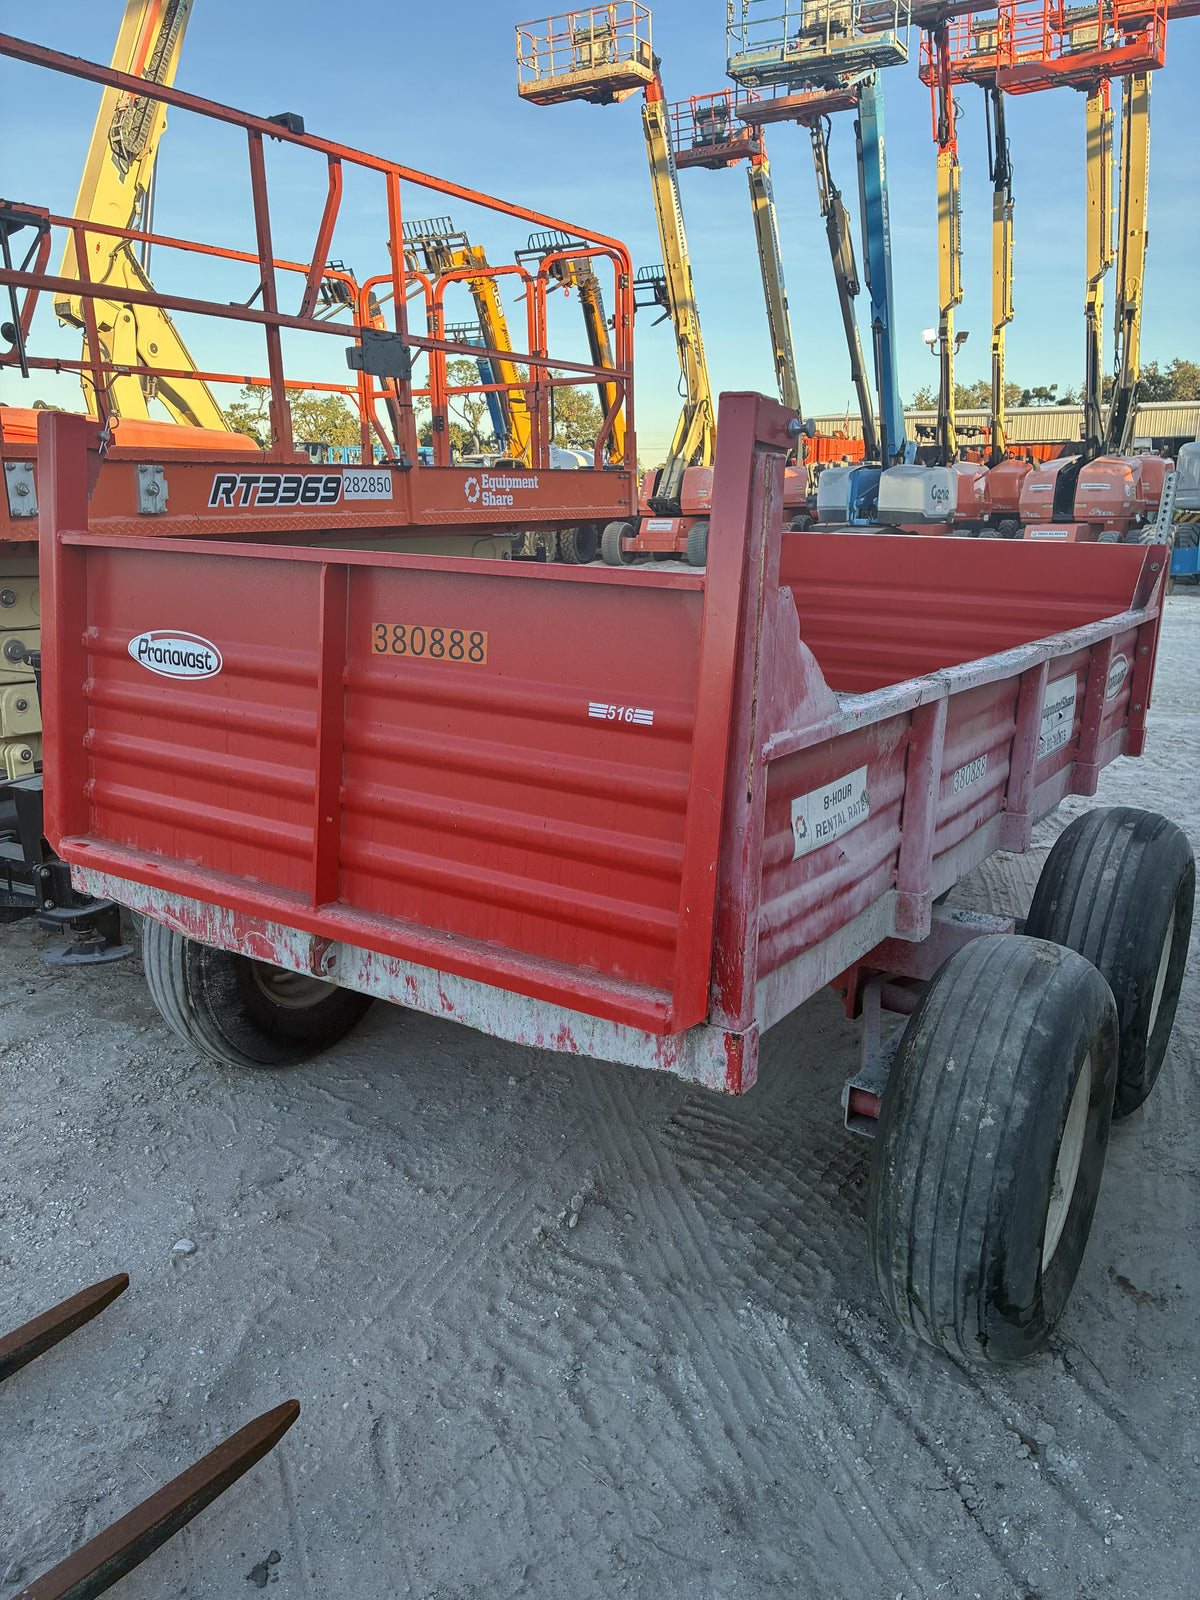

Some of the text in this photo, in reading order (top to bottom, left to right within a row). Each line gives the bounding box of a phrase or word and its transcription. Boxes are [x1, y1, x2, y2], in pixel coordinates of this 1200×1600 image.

[492, 286, 504, 318] JCB
[208, 473, 391, 507] RT3369 282850
[481, 474, 539, 492] Equipment
[931, 484, 950, 501] Genie
[481, 492, 514, 506] Share
[374, 623, 484, 663] 380888
[607, 705, 634, 722] 516
[954, 756, 986, 792] 380888
[823, 783, 852, 811] 8-HOUR
[815, 811, 847, 839] RENTAL
